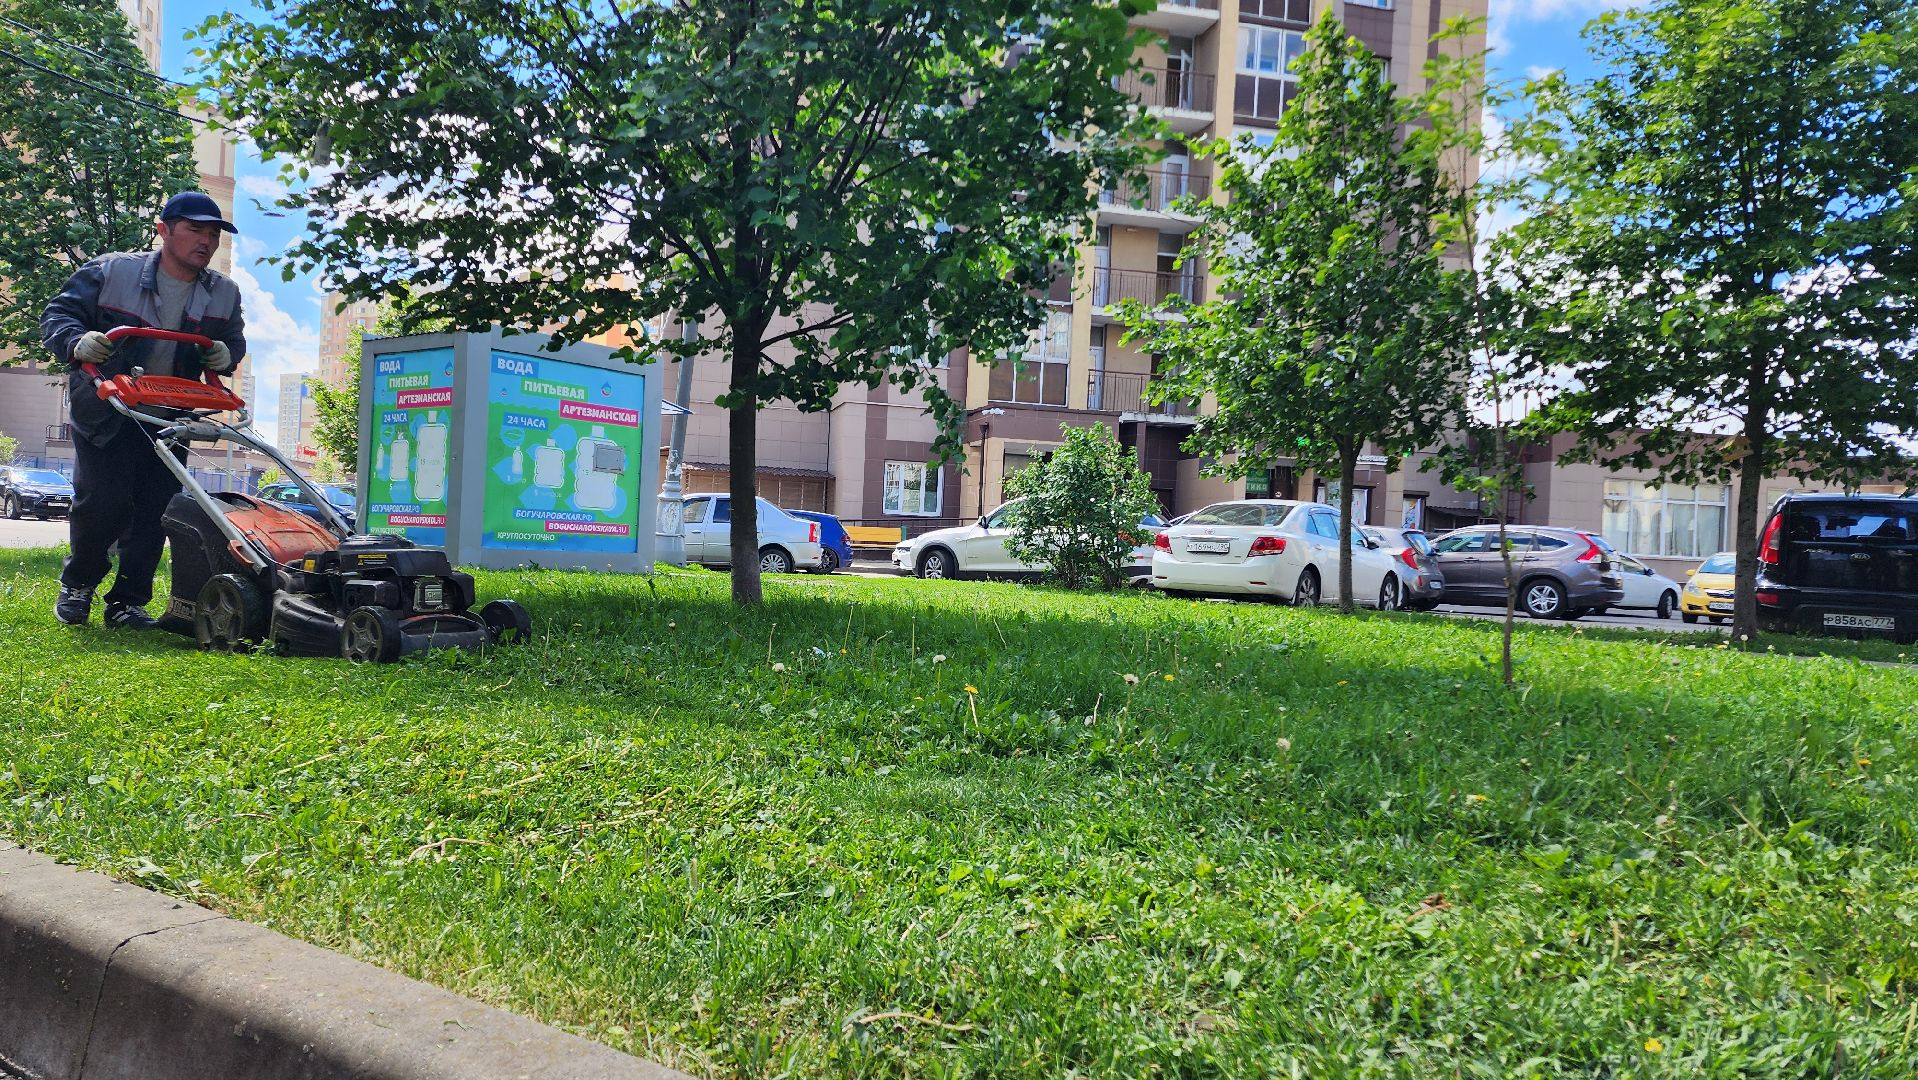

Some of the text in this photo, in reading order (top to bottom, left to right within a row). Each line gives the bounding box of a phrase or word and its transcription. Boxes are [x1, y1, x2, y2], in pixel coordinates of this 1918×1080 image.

[380, 360, 401, 374] ВОДА
[497, 358, 534, 376] ВОДА
[389, 375, 429, 388] ПИТЬЕВАЯ
[524, 380, 585, 400] ПИТЬЕВАЯ
[398, 391, 451, 405] АРТЕЗИАНСКАЯ
[383, 412, 408, 423] 24 ЧАСА
[562, 404, 638, 423] АРТЕЗИАНСКАЯ
[507, 415, 546, 429] 24 ЧАСА
[515, 509, 593, 522] БОГУЧАРОВСКАЯ.РФ
[497, 531, 555, 541] КРУГЛОСУТОЧНО
